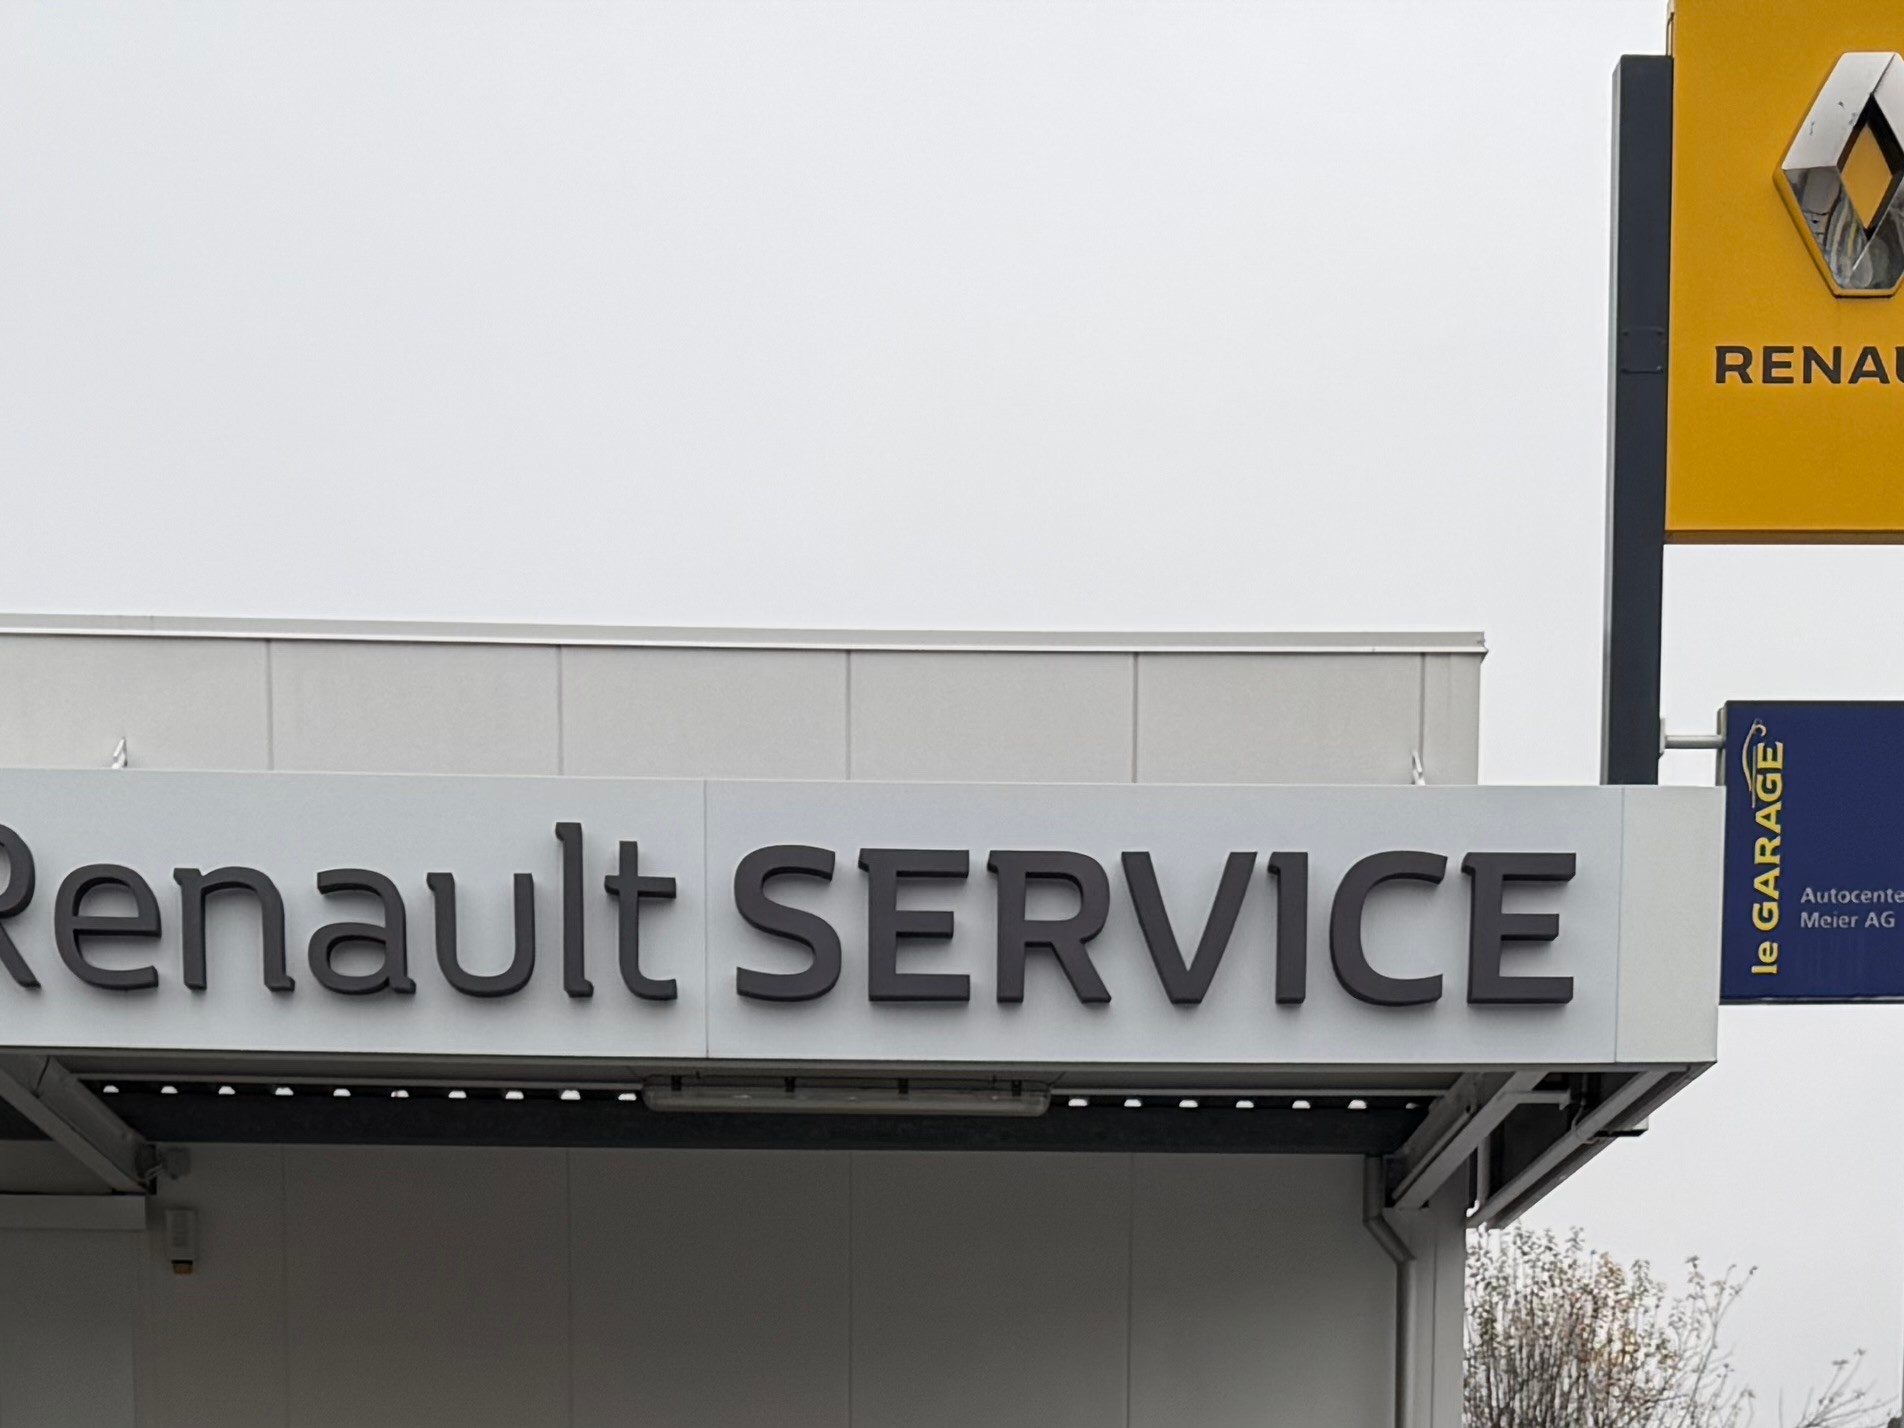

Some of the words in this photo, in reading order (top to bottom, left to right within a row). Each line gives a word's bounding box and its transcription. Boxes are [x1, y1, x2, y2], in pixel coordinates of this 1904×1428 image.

[1752, 740, 1784, 932] GARAGE
[733, 843, 1577, 1007] SERVICE
[1751, 941, 1779, 976] le
[1799, 911, 1859, 928] Meier
[1864, 911, 1896, 928] AG
